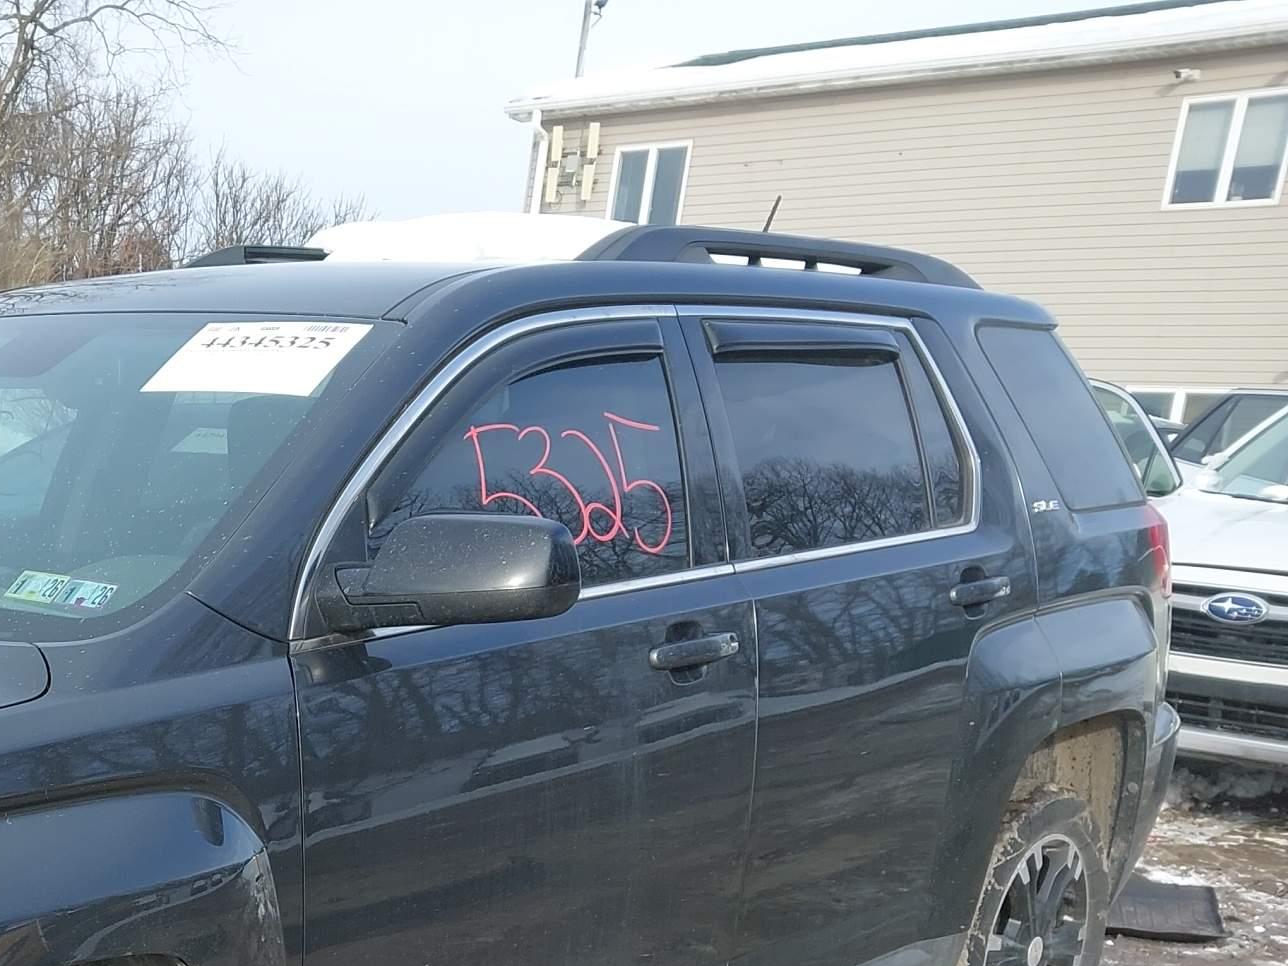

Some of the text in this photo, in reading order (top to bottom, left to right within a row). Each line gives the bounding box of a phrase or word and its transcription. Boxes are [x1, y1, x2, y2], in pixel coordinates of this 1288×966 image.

[201, 335, 336, 349] 44345325
[463, 411, 673, 554] 5325
[91, 585, 115, 606] 26
